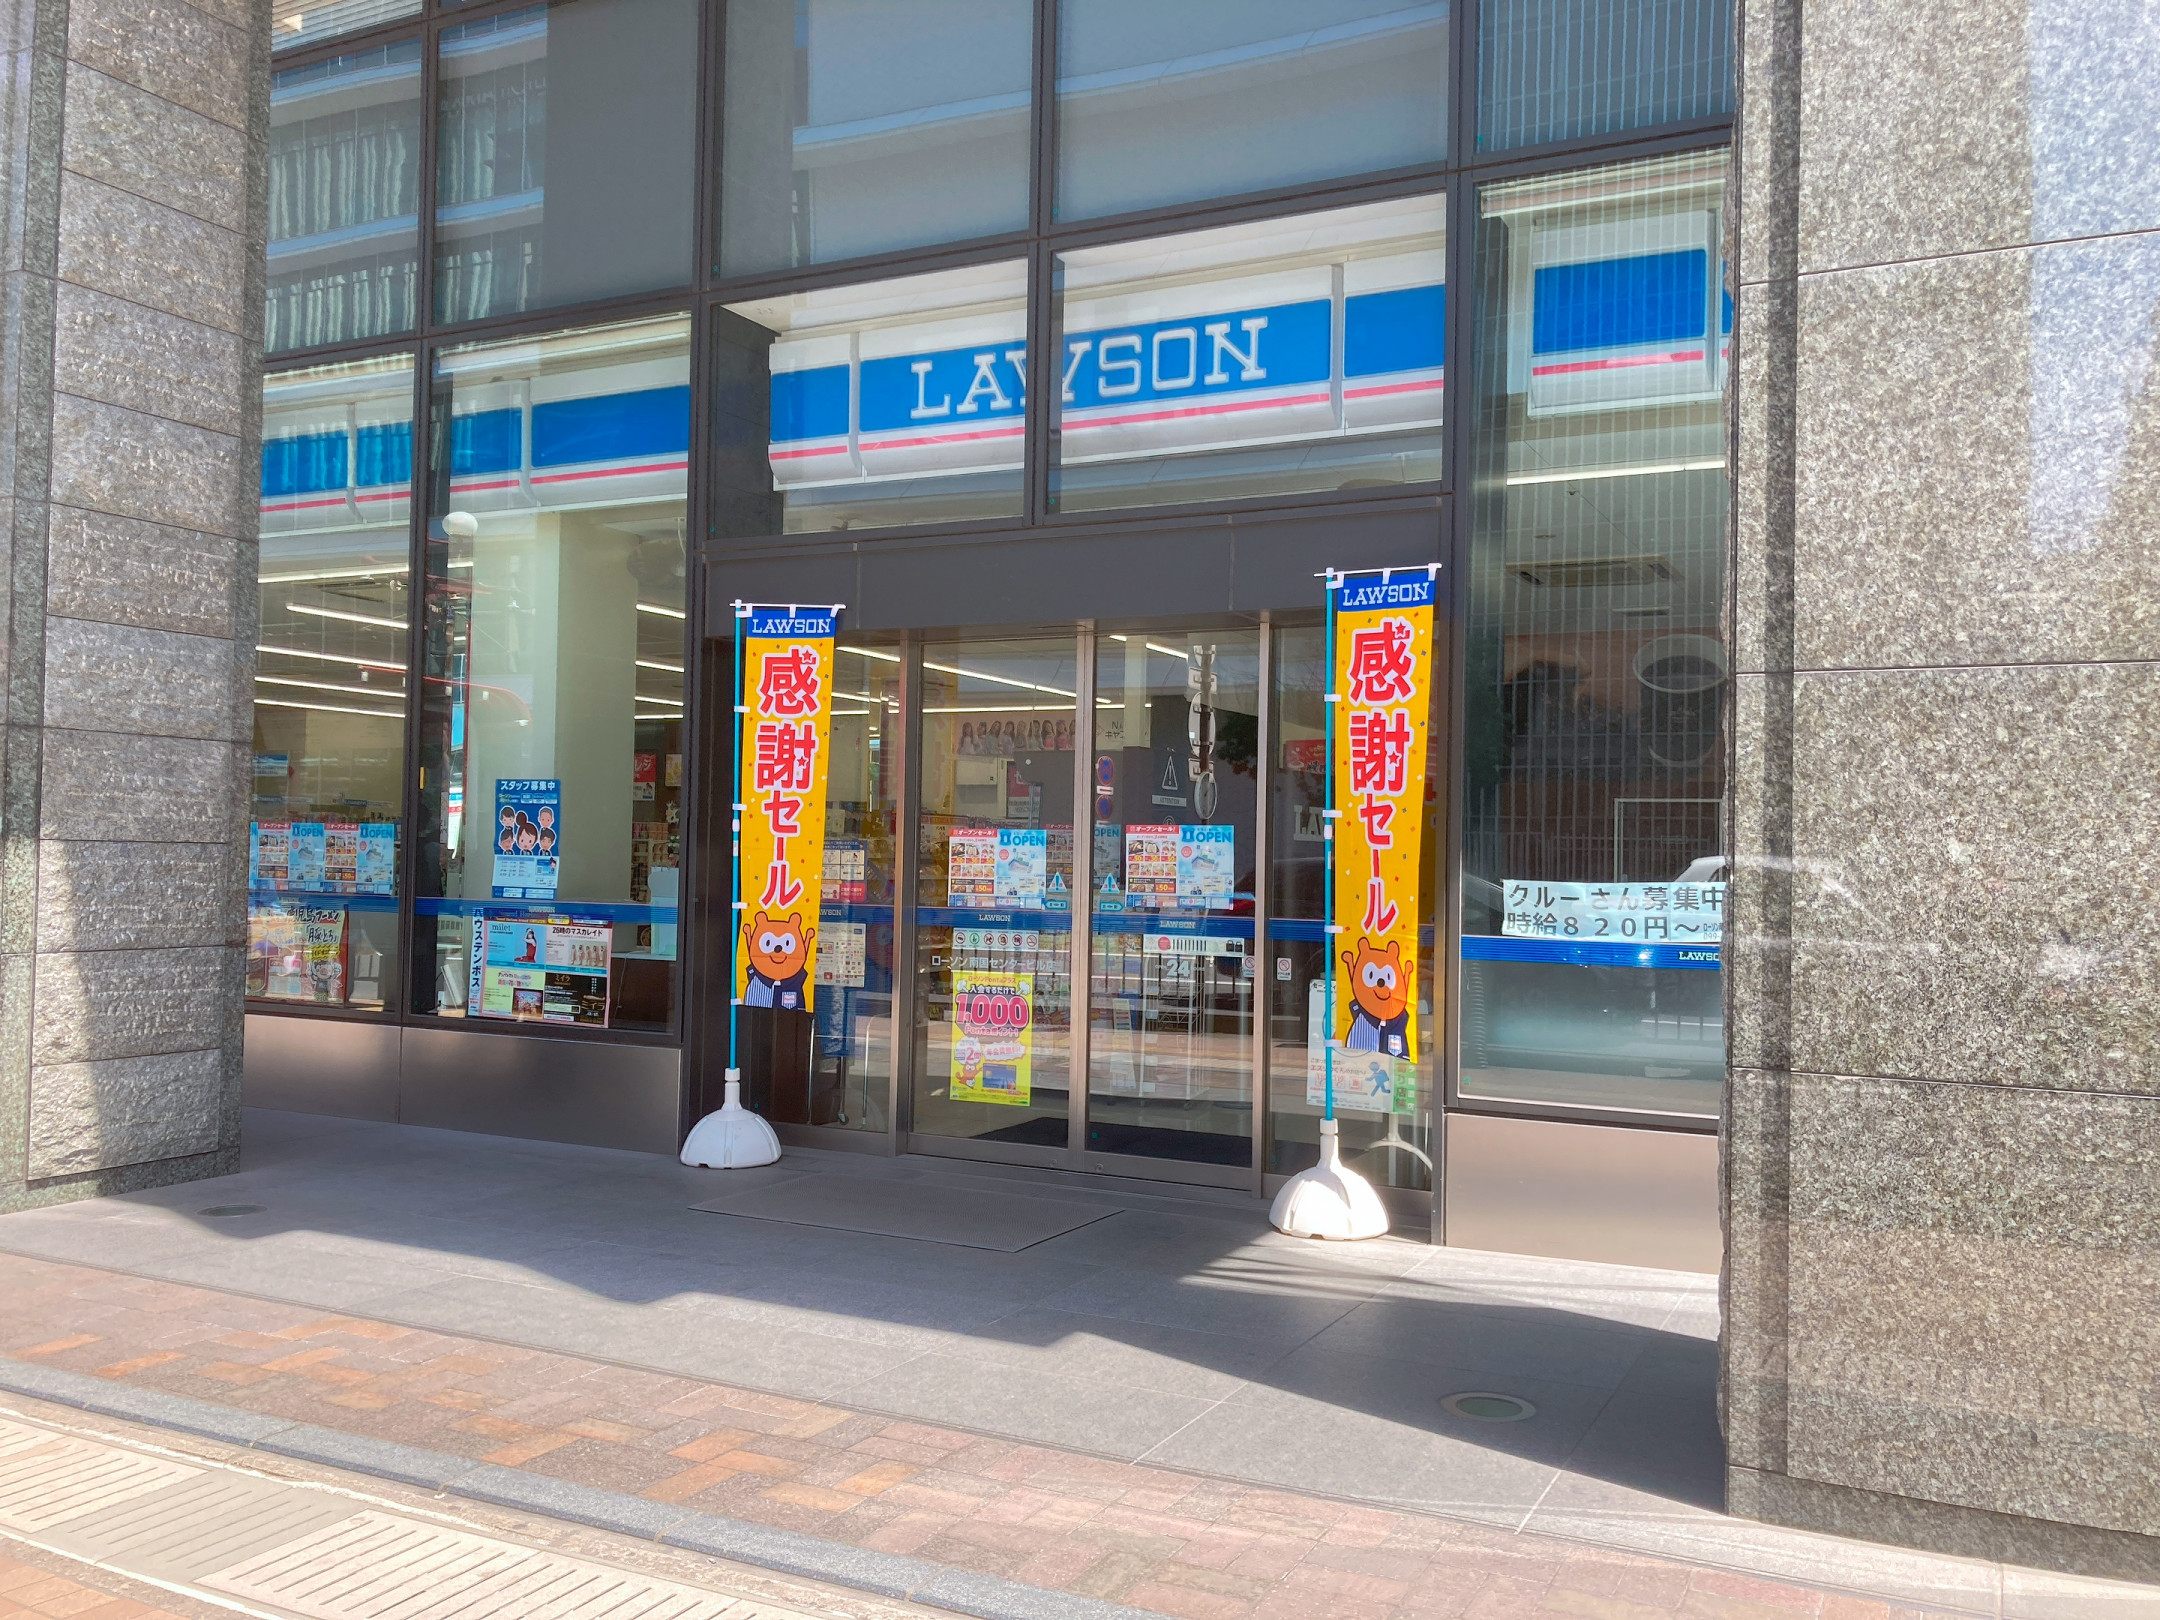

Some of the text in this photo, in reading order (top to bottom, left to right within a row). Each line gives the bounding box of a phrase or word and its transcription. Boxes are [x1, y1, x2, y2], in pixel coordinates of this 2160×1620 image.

[910, 316, 1268, 420] LAWSON
[1342, 582, 1430, 607] LAWSON
[752, 618, 831, 634] LAWSON
[756, 647, 819, 908] 感謝セール
[1348, 620, 1413, 934] 感謝セール
[500, 781, 555, 791] スタッフ募集中
[301, 828, 324, 837] OPEN
[369, 829, 393, 838] OPEN
[1196, 831, 1232, 843] OPEN
[1012, 835, 1045, 847] OPEN
[1509, 884, 1723, 911] クルーさん募集中
[979, 914, 1011, 922] LAWSON
[491, 923, 511, 931] milet
[1159, 920, 1196, 929] LAWSON
[552, 926, 603, 937] 26時のマスカレイド
[1678, 951, 1720, 961] LAWSO
[932, 955, 1056, 972] ローソン南国センタービル店
[1166, 959, 1190, 977] 24
[968, 975, 1017, 985] ローソンPontaプラス
[970, 985, 1016, 996] 入会するだけで
[956, 993, 1030, 1029] 1,000
